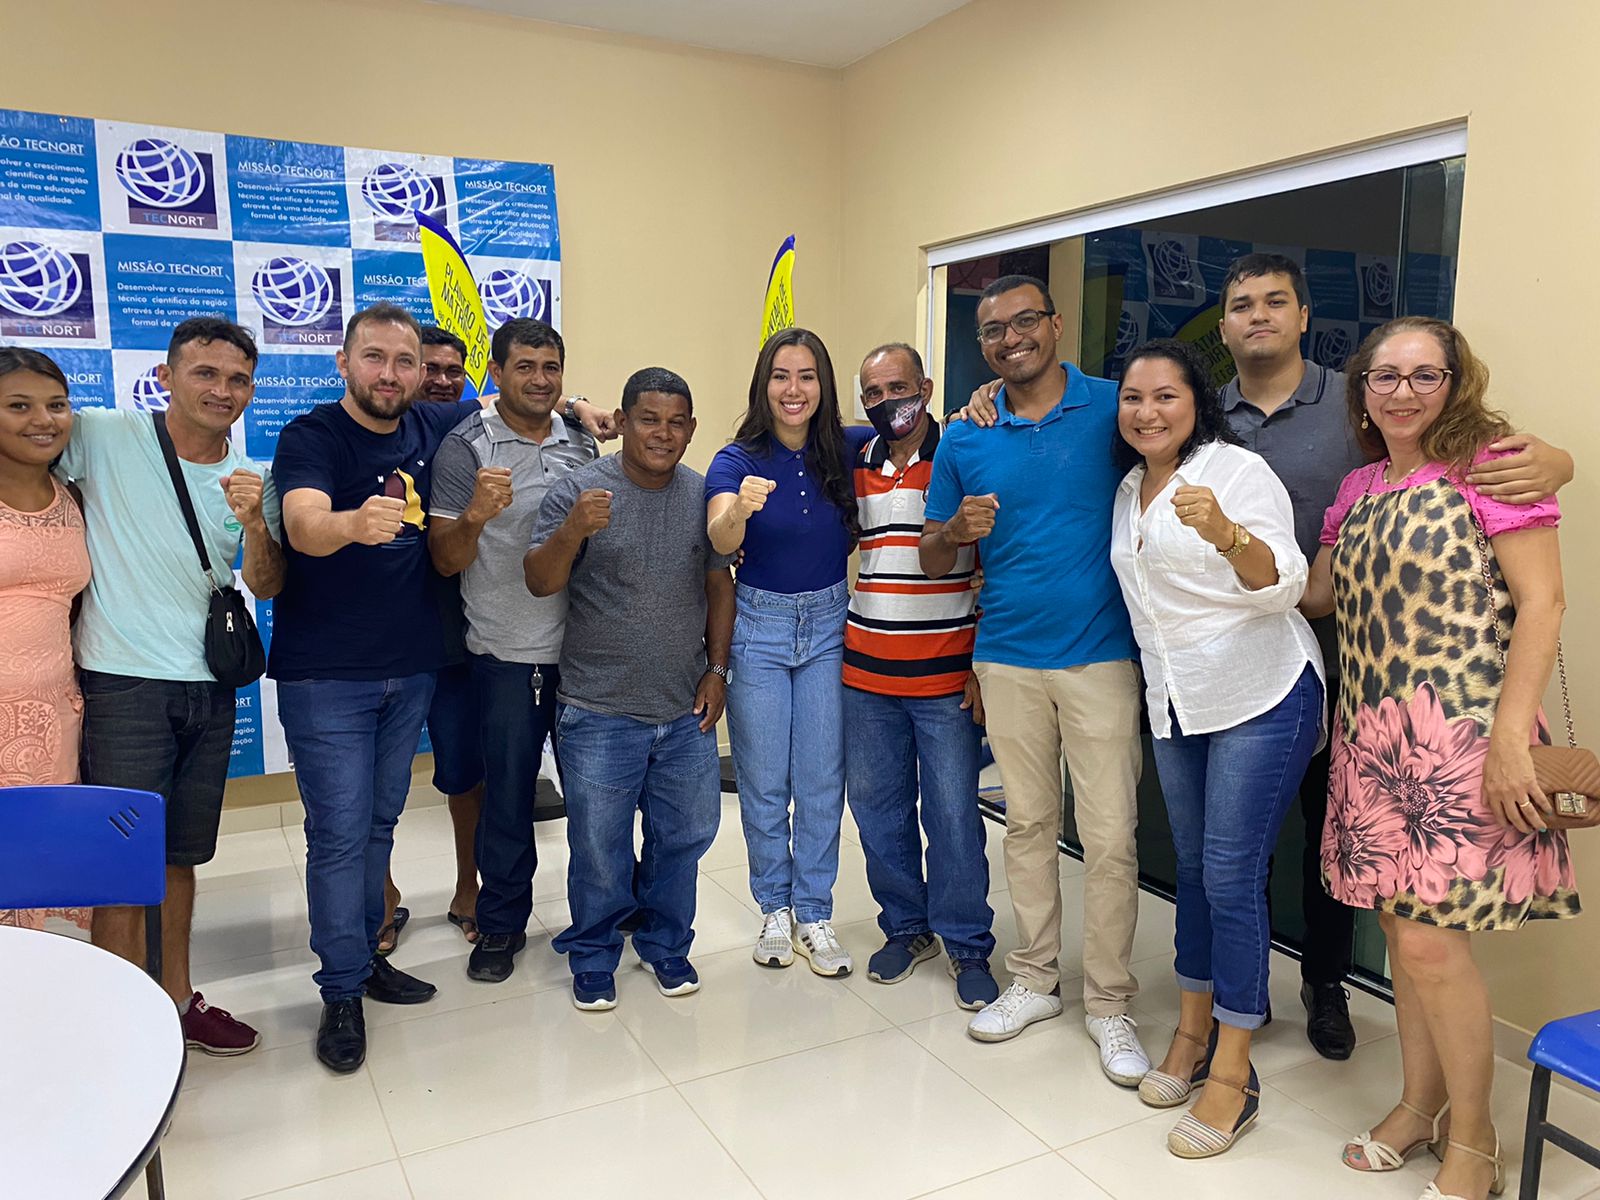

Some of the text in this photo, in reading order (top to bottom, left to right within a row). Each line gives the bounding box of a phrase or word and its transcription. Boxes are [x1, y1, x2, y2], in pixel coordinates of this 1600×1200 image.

[24, 138, 84, 155] TECNORT
[33, 162, 86, 174] crescimento
[284, 165, 335, 179] TECNORT
[46, 173, 58, 182] da
[7, 180, 19, 188] de
[21, 183, 42, 191] uma
[237, 181, 284, 192] Desenvolver
[292, 187, 336, 196] crescimento
[464, 179, 547, 194] MISSÃO TECNORT
[14, 192, 26, 201] de
[271, 203, 282, 211] de
[511, 201, 548, 210] crescimento
[143, 212, 205, 226] TECNORT
[250, 211, 276, 220] formal
[117, 260, 224, 276] MISSÃO TECNORT
[363, 274, 404, 285] MISSÃO
[117, 282, 168, 292] Desenvolver
[177, 286, 225, 295] crescimento
[131, 318, 159, 327] formal
[160, 319, 171, 327] de
[67, 373, 102, 384] NORT
[253, 375, 296, 386] MISSÃO
[252, 396, 298, 404] Desenvolver
[234, 727, 255, 736] egião
